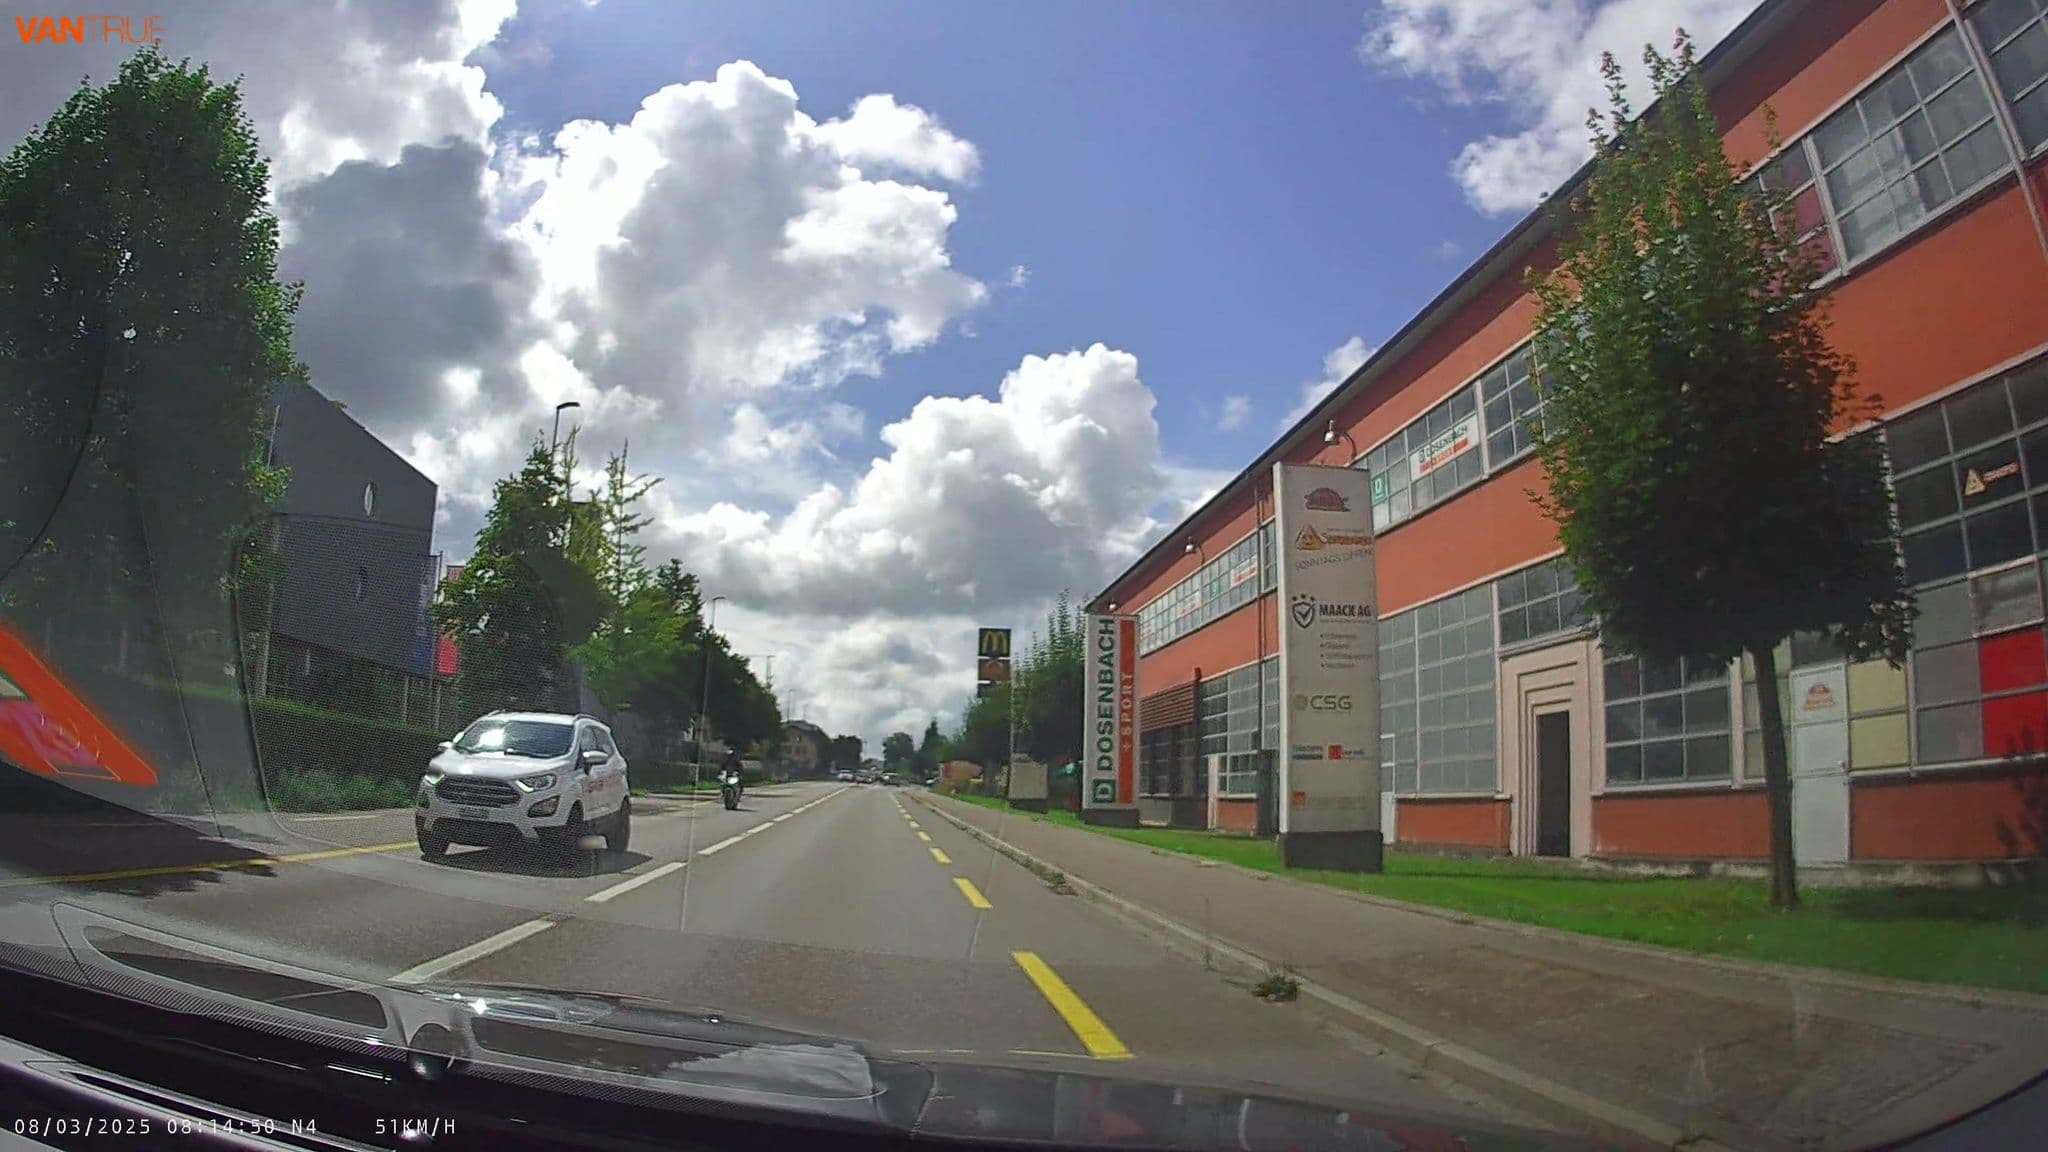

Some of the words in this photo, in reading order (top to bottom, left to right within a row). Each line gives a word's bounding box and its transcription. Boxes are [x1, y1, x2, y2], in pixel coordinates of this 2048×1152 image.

[1320, 603, 1355, 617] MAACK
[1357, 604, 1372, 617] AG
[1096, 618, 1115, 771] DOSENBACH
[1121, 672, 1133, 737] SPORT
[1310, 694, 1353, 710] CSG
